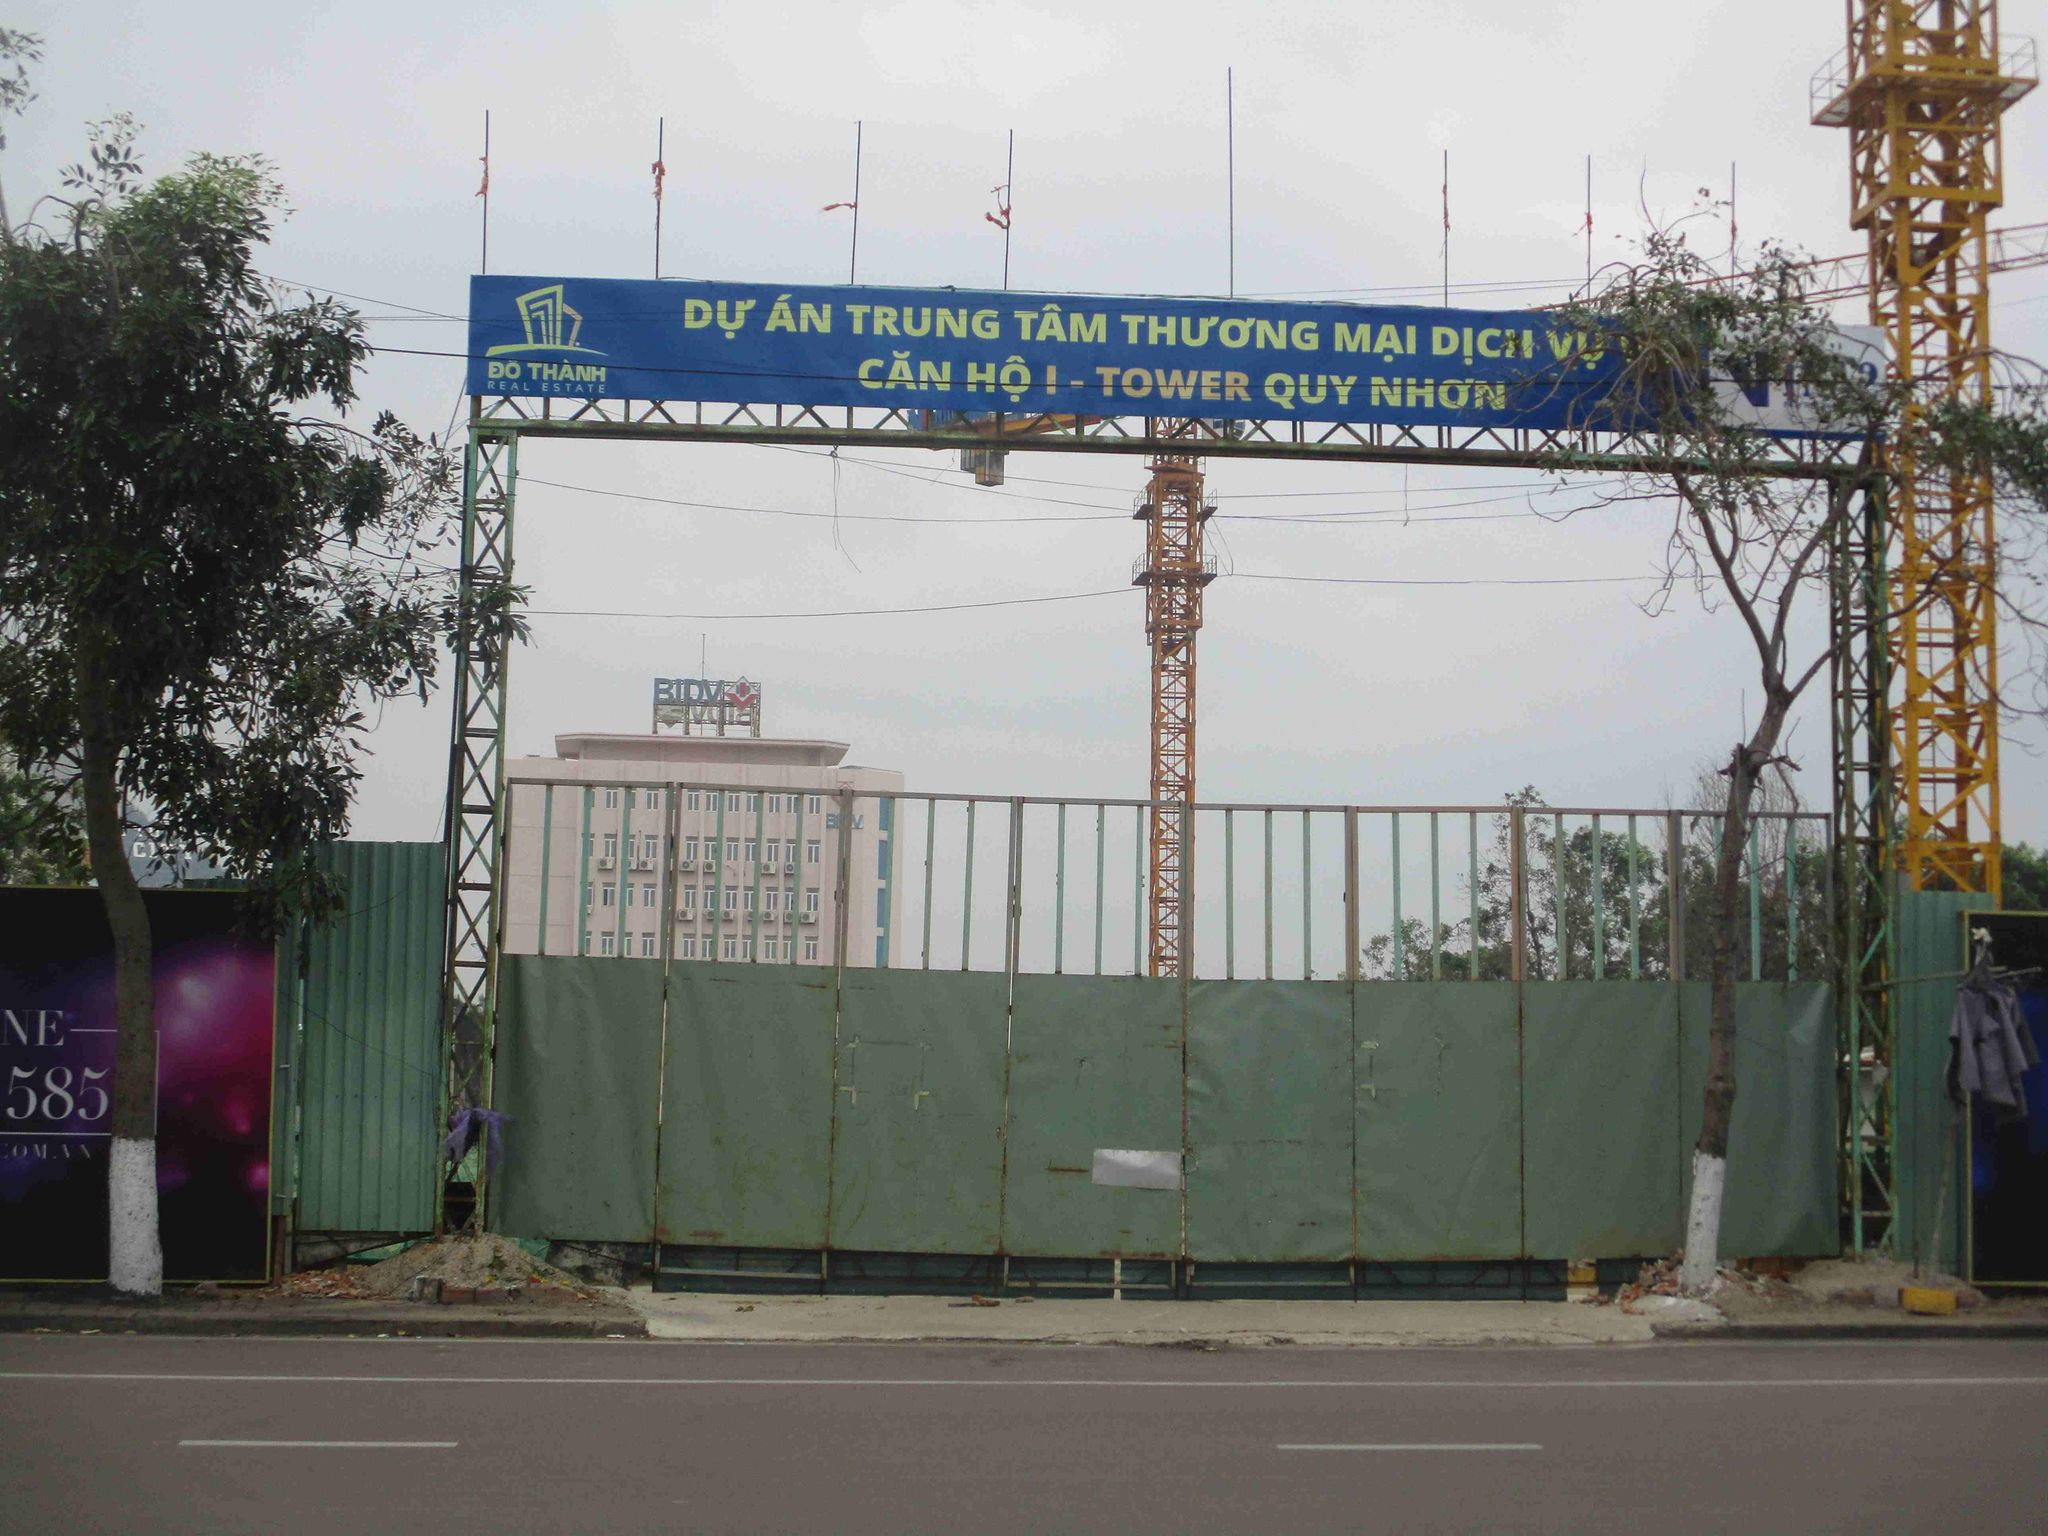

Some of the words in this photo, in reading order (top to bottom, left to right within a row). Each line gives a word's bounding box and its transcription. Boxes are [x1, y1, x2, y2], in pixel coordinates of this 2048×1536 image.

[683, 298, 756, 340] DỰ
[764, 294, 832, 333] ÁN
[846, 304, 1001, 340] TRUNG
[1013, 303, 1107, 344] TÂM
[1121, 314, 1320, 352] THƯƠNG
[1334, 322, 1417, 363] MẠI
[1432, 326, 1534, 366] DỊCH
[487, 381, 530, 391] REAL
[541, 383, 605, 393] ESTATE
[527, 358, 607, 383] THÀNH
[858, 350, 951, 392] CĂN
[966, 355, 1031, 403] HỘ
[1045, 364, 1057, 396] I
[1095, 366, 1252, 402] TOWER
[1264, 372, 1358, 410] QUY
[1370, 376, 1507, 410] NHƠN
[653, 677, 725, 706] BIDV
[6, 1065, 110, 1121] 585
